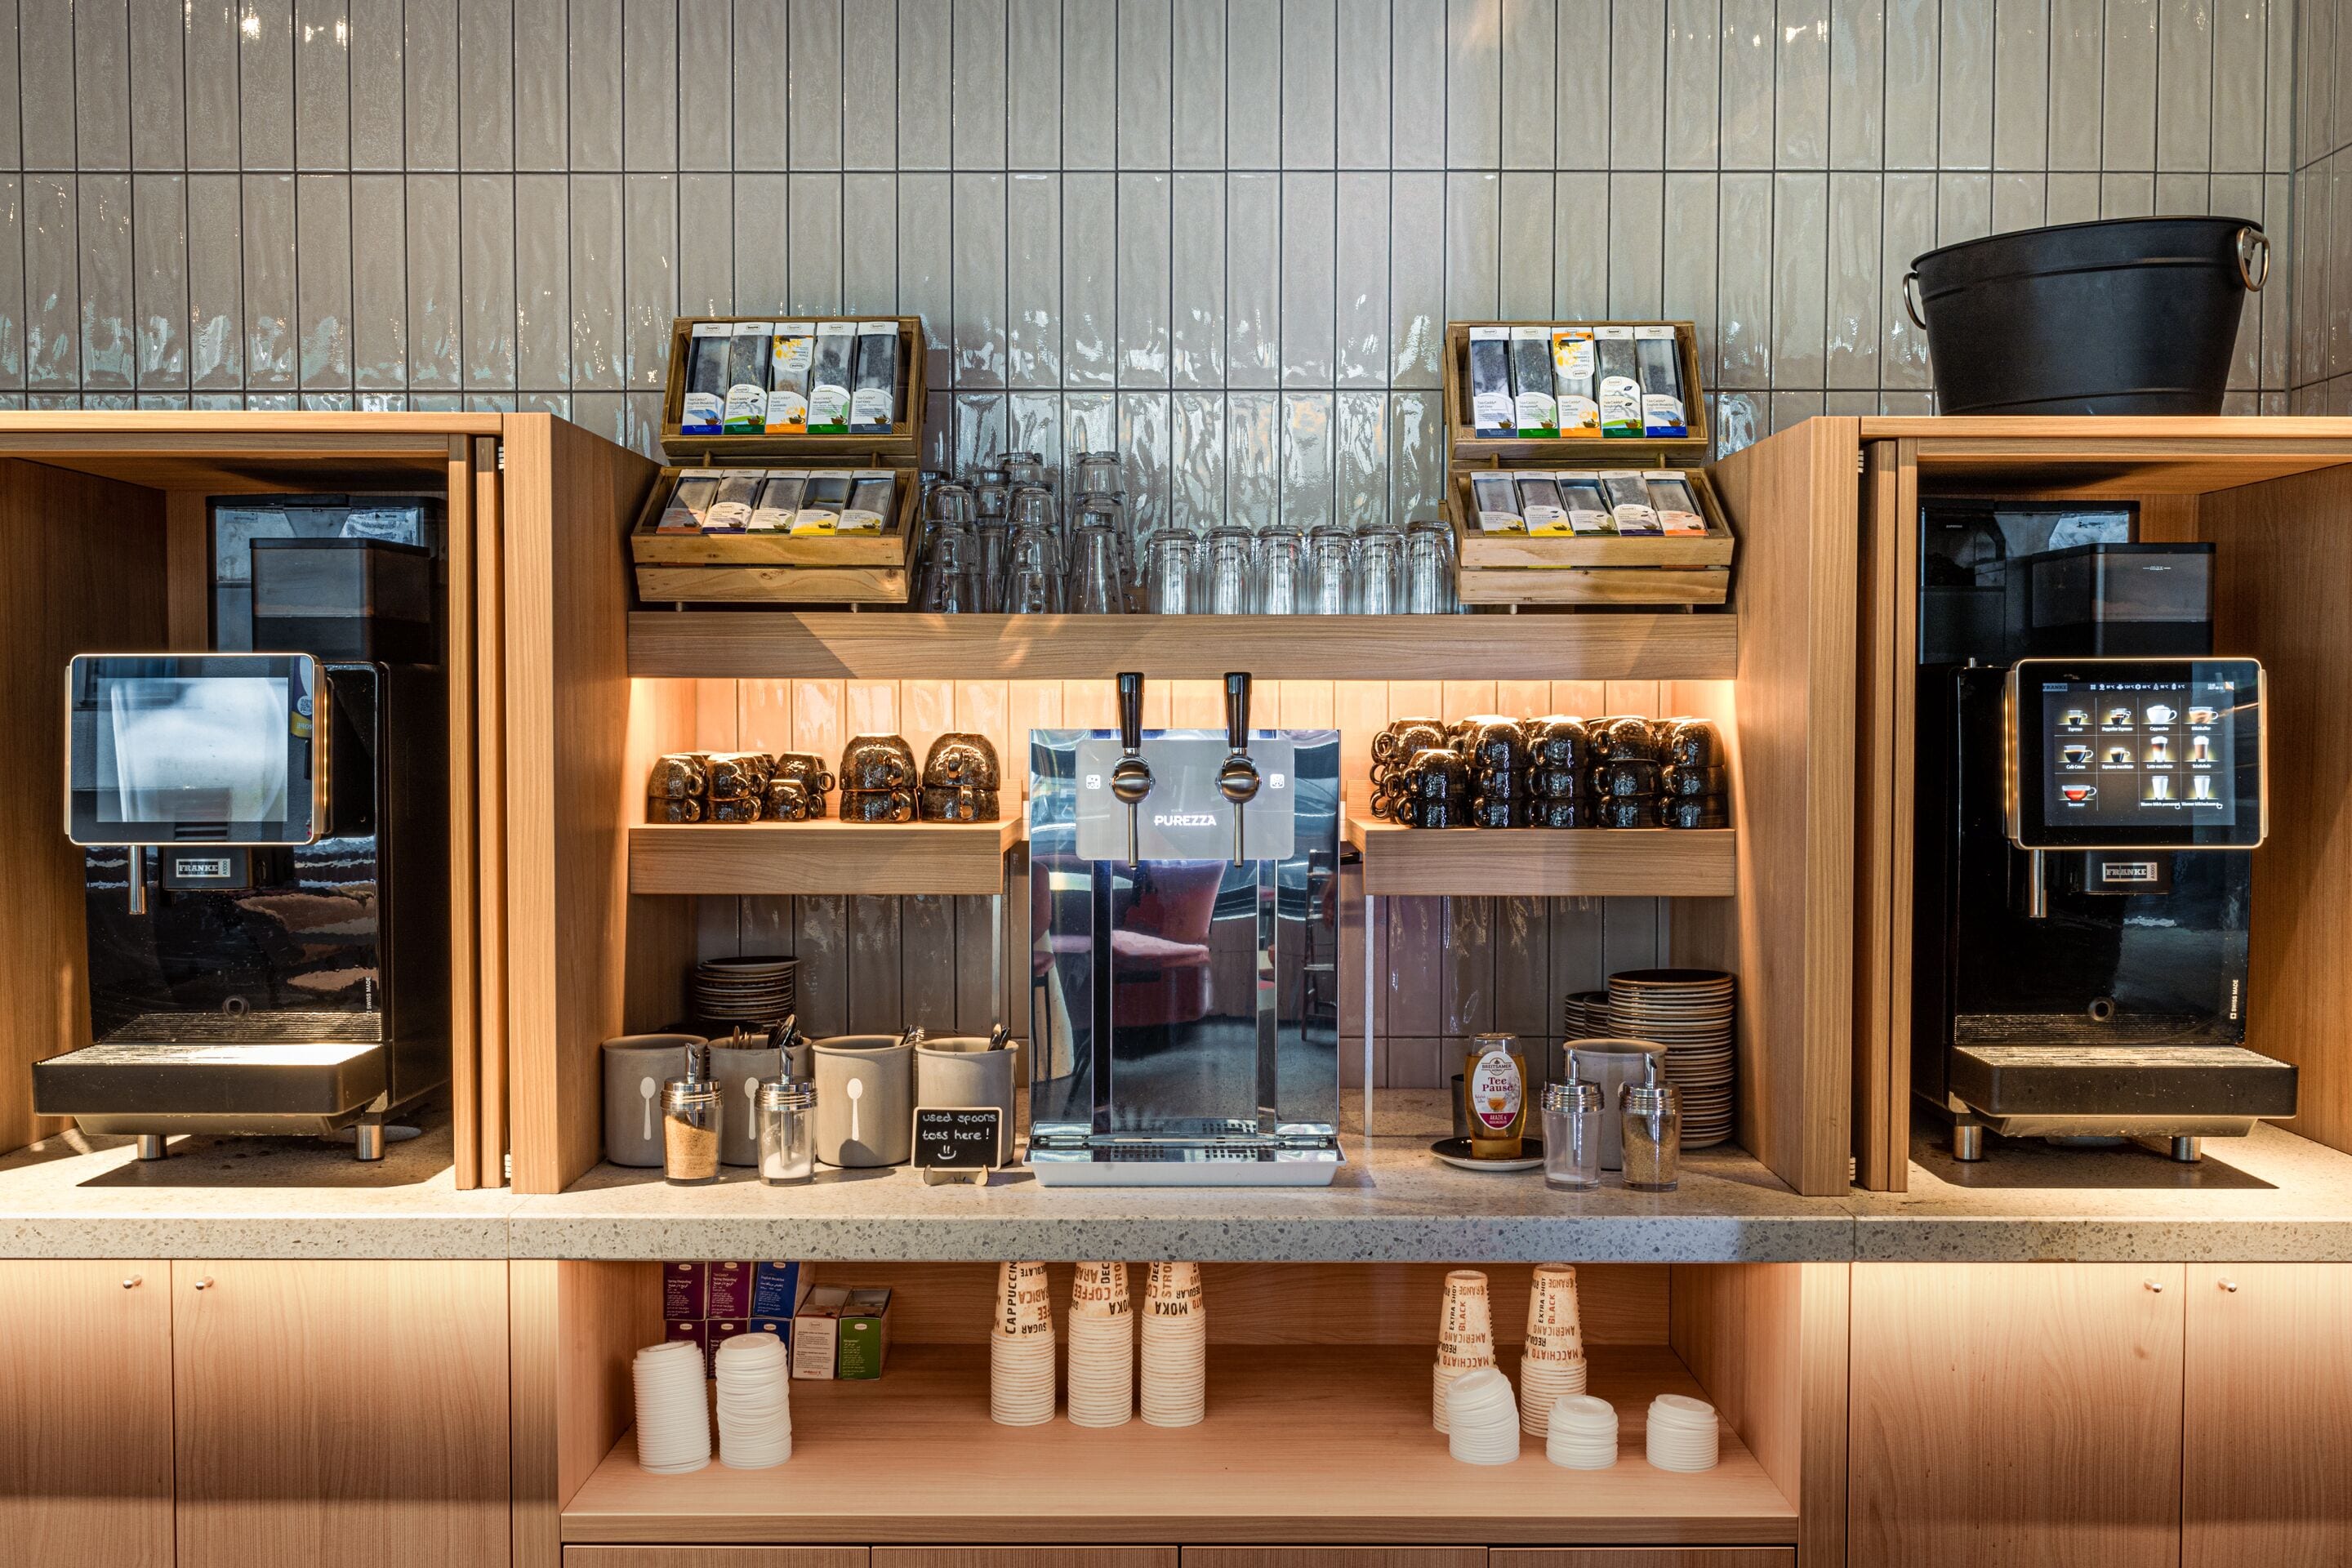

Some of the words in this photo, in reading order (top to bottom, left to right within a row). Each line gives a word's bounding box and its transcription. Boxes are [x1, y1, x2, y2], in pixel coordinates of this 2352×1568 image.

[1154, 815, 1217, 826] PUREZZA
[923, 1112, 952, 1122] used
[957, 1114, 996, 1125] spoons
[922, 1129, 948, 1140] toss
[1114, 1262, 1124, 1297] STRO
[1162, 1262, 1172, 1298] STRO
[1548, 1278, 1574, 1289] GRANDE
[1074, 1283, 1111, 1301] COFFEE
[1459, 1285, 1485, 1296] GRANDE
[1155, 1301, 1187, 1316] MOKA
[1548, 1294, 1556, 1325] BLACK
[1022, 1322, 1047, 1334] SUGAR
[1533, 1325, 1575, 1337] AMERICANO
[1444, 1331, 1486, 1344] AMERICANO
[1531, 1348, 1579, 1361] MACCHIATO
[1442, 1356, 1489, 1368] MACCHIATO
